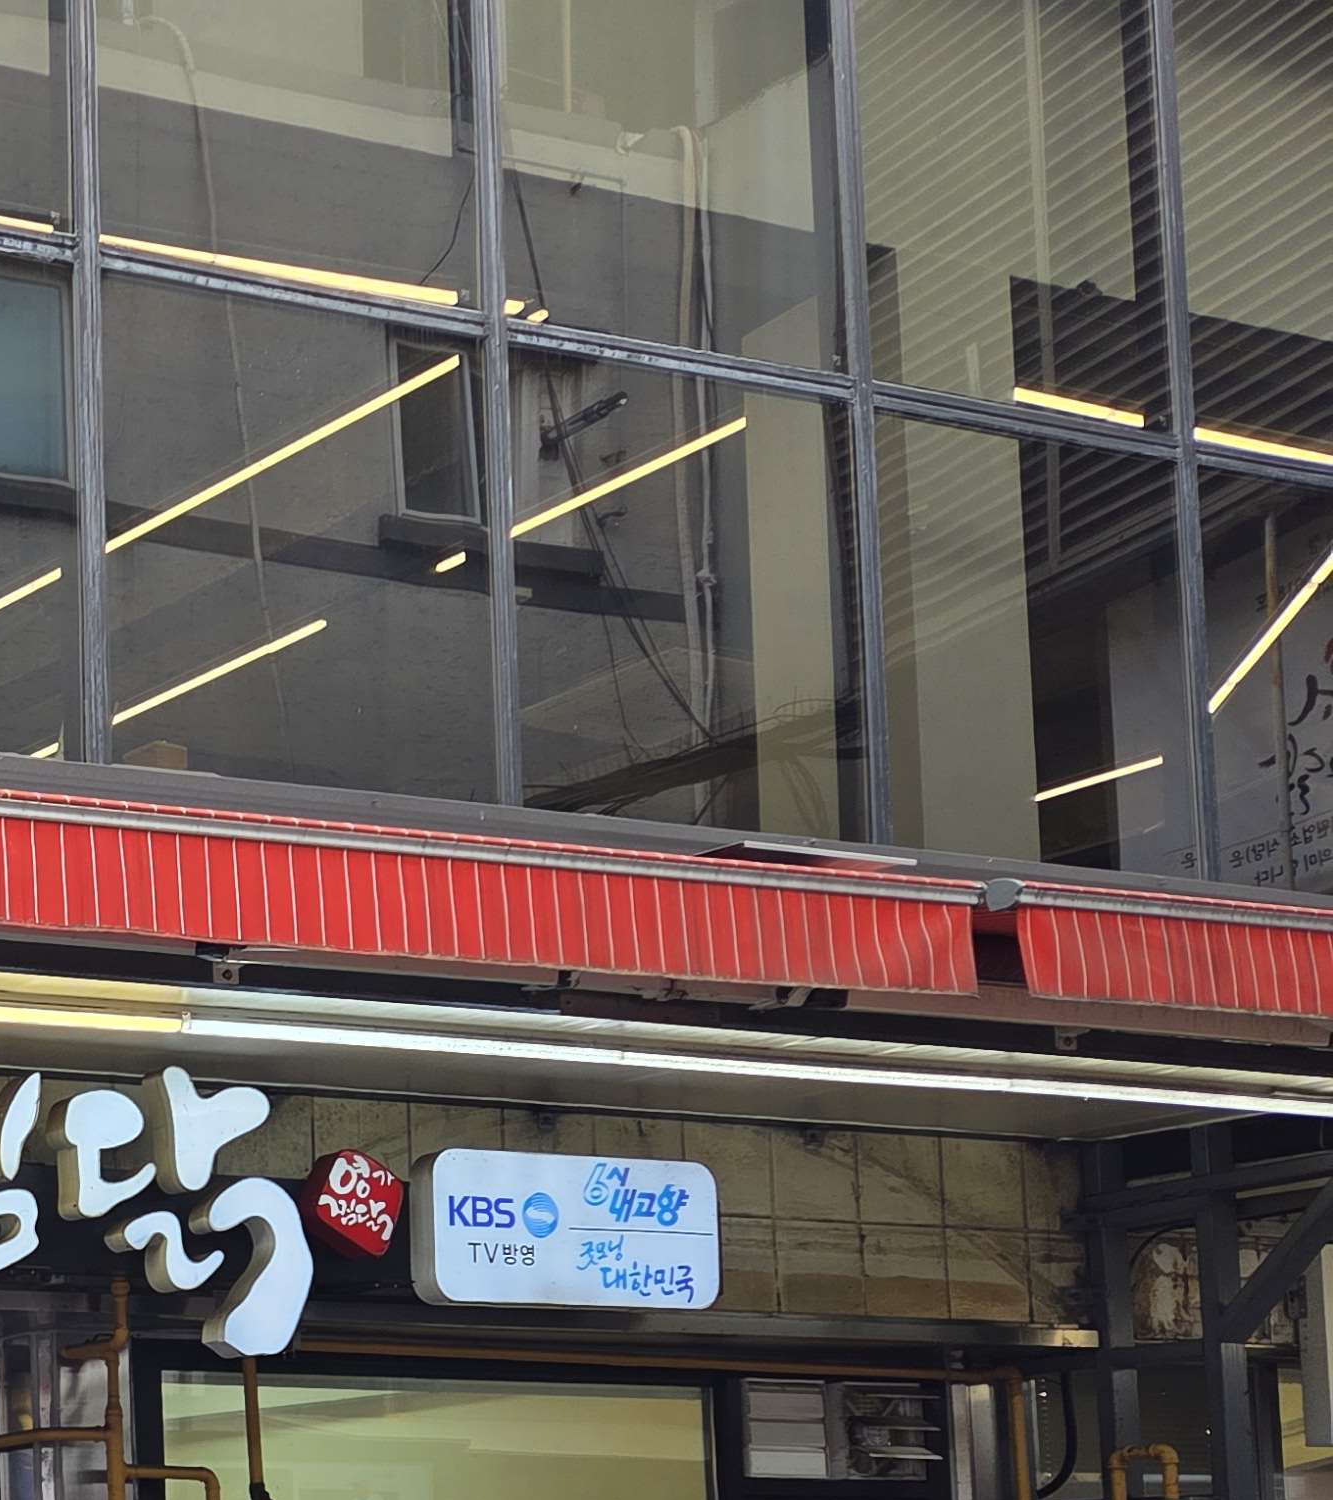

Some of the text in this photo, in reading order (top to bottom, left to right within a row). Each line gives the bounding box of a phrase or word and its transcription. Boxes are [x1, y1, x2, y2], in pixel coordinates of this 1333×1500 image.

[583, 1163, 630, 1207] 6시
[448, 1195, 516, 1229] KBS
[608, 1184, 690, 1227] 내고향
[576, 1234, 625, 1271] 굿모닝
[599, 1265, 695, 1303] 대한민국
